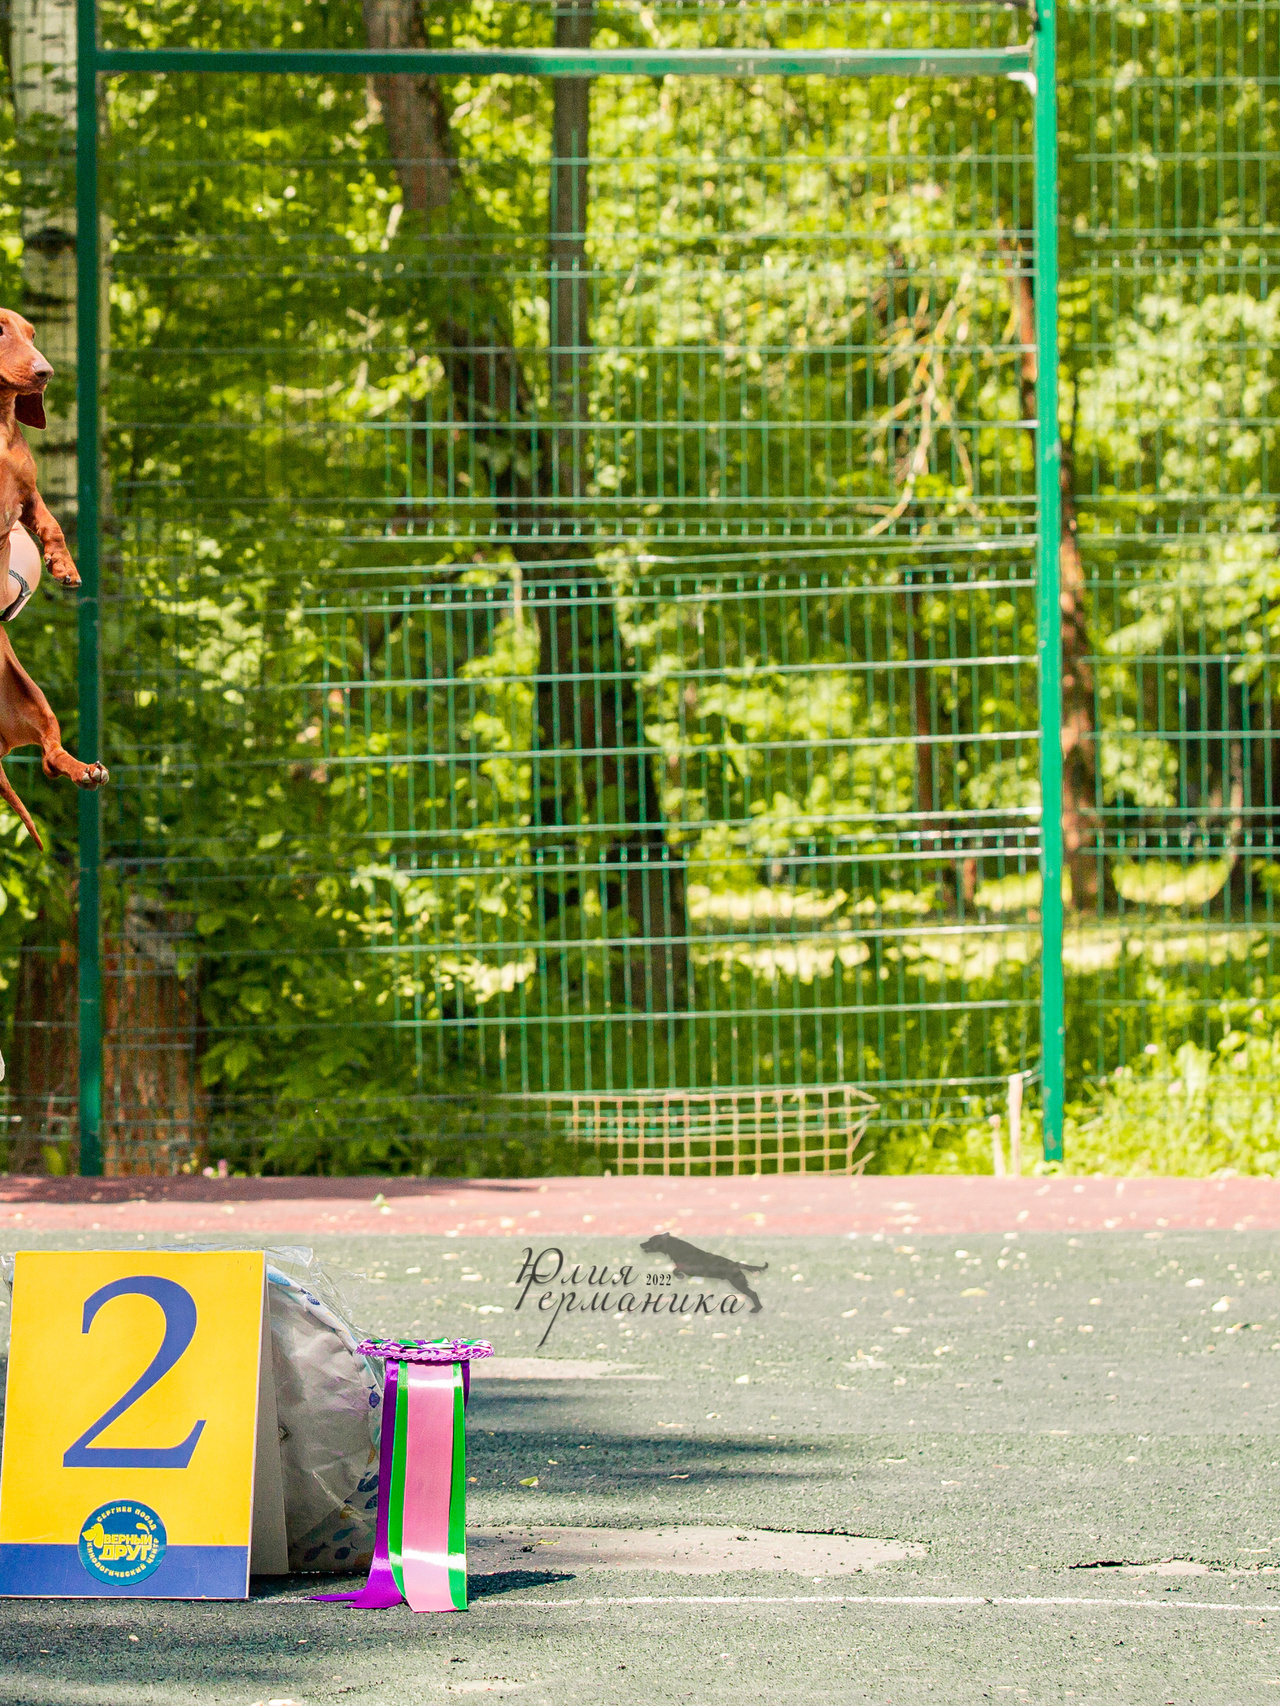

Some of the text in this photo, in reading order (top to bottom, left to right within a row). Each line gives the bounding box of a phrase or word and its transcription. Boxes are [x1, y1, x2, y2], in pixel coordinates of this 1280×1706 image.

[62, 1275, 207, 1469] 2
[96, 1506, 157, 1531] СЕРГИЕВ ПОСАД
[86, 1541, 147, 1577] КИНОЛОГИЧЕСКИЙ
[98, 1544, 152, 1561] ДРУГ
